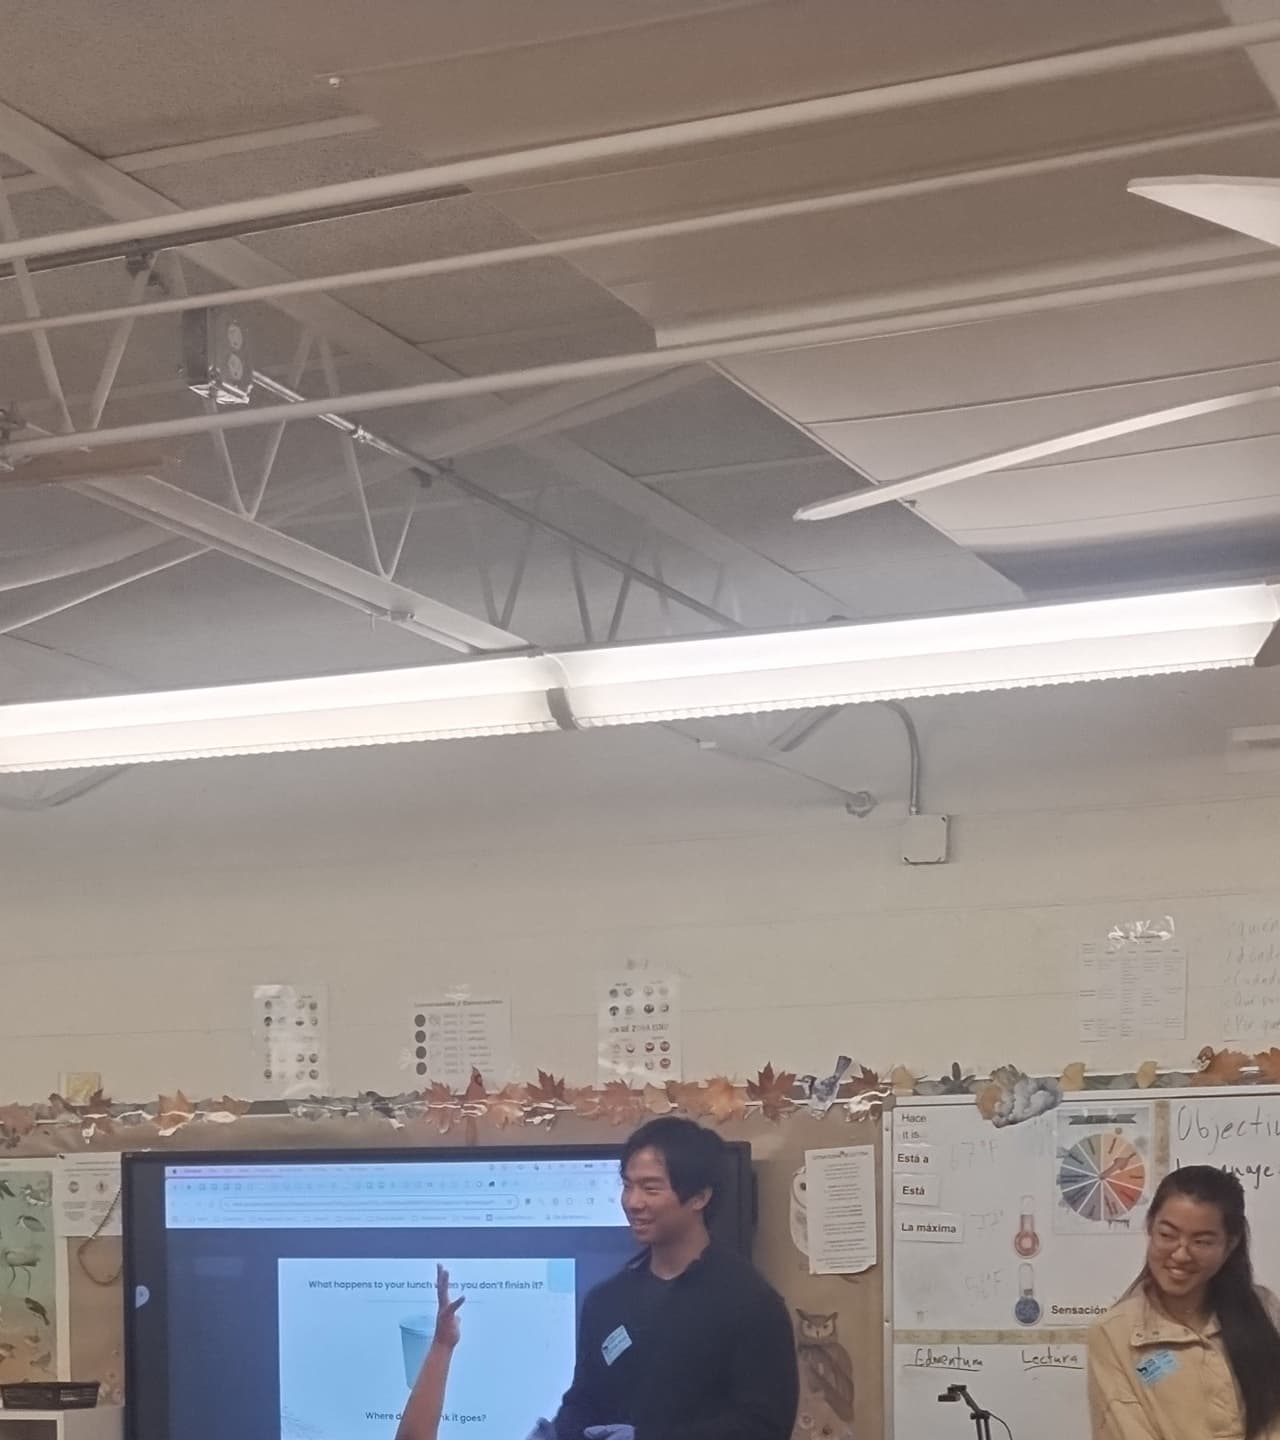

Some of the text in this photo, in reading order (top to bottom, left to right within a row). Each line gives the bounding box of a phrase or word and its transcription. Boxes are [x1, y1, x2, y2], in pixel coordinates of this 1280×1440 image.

[898, 1153, 920, 1163] Está
[902, 1185, 925, 1195] Está
[901, 1223, 956, 1233] La máxima
[308, 1280, 332, 1289] What
[333, 1280, 372, 1290] happens
[374, 1281, 383, 1289] to
[385, 1282, 405, 1290] your
[407, 1280, 433, 1289] lunch
[460, 1282, 478, 1290] you
[505, 1280, 530, 1289] finish
[532, 1280, 543, 1289] it?
[1022, 1347, 1078, 1364] Lectura
[365, 1412, 394, 1421] Where
[452, 1413, 459, 1421] it
[460, 1414, 486, 1424] goes?
